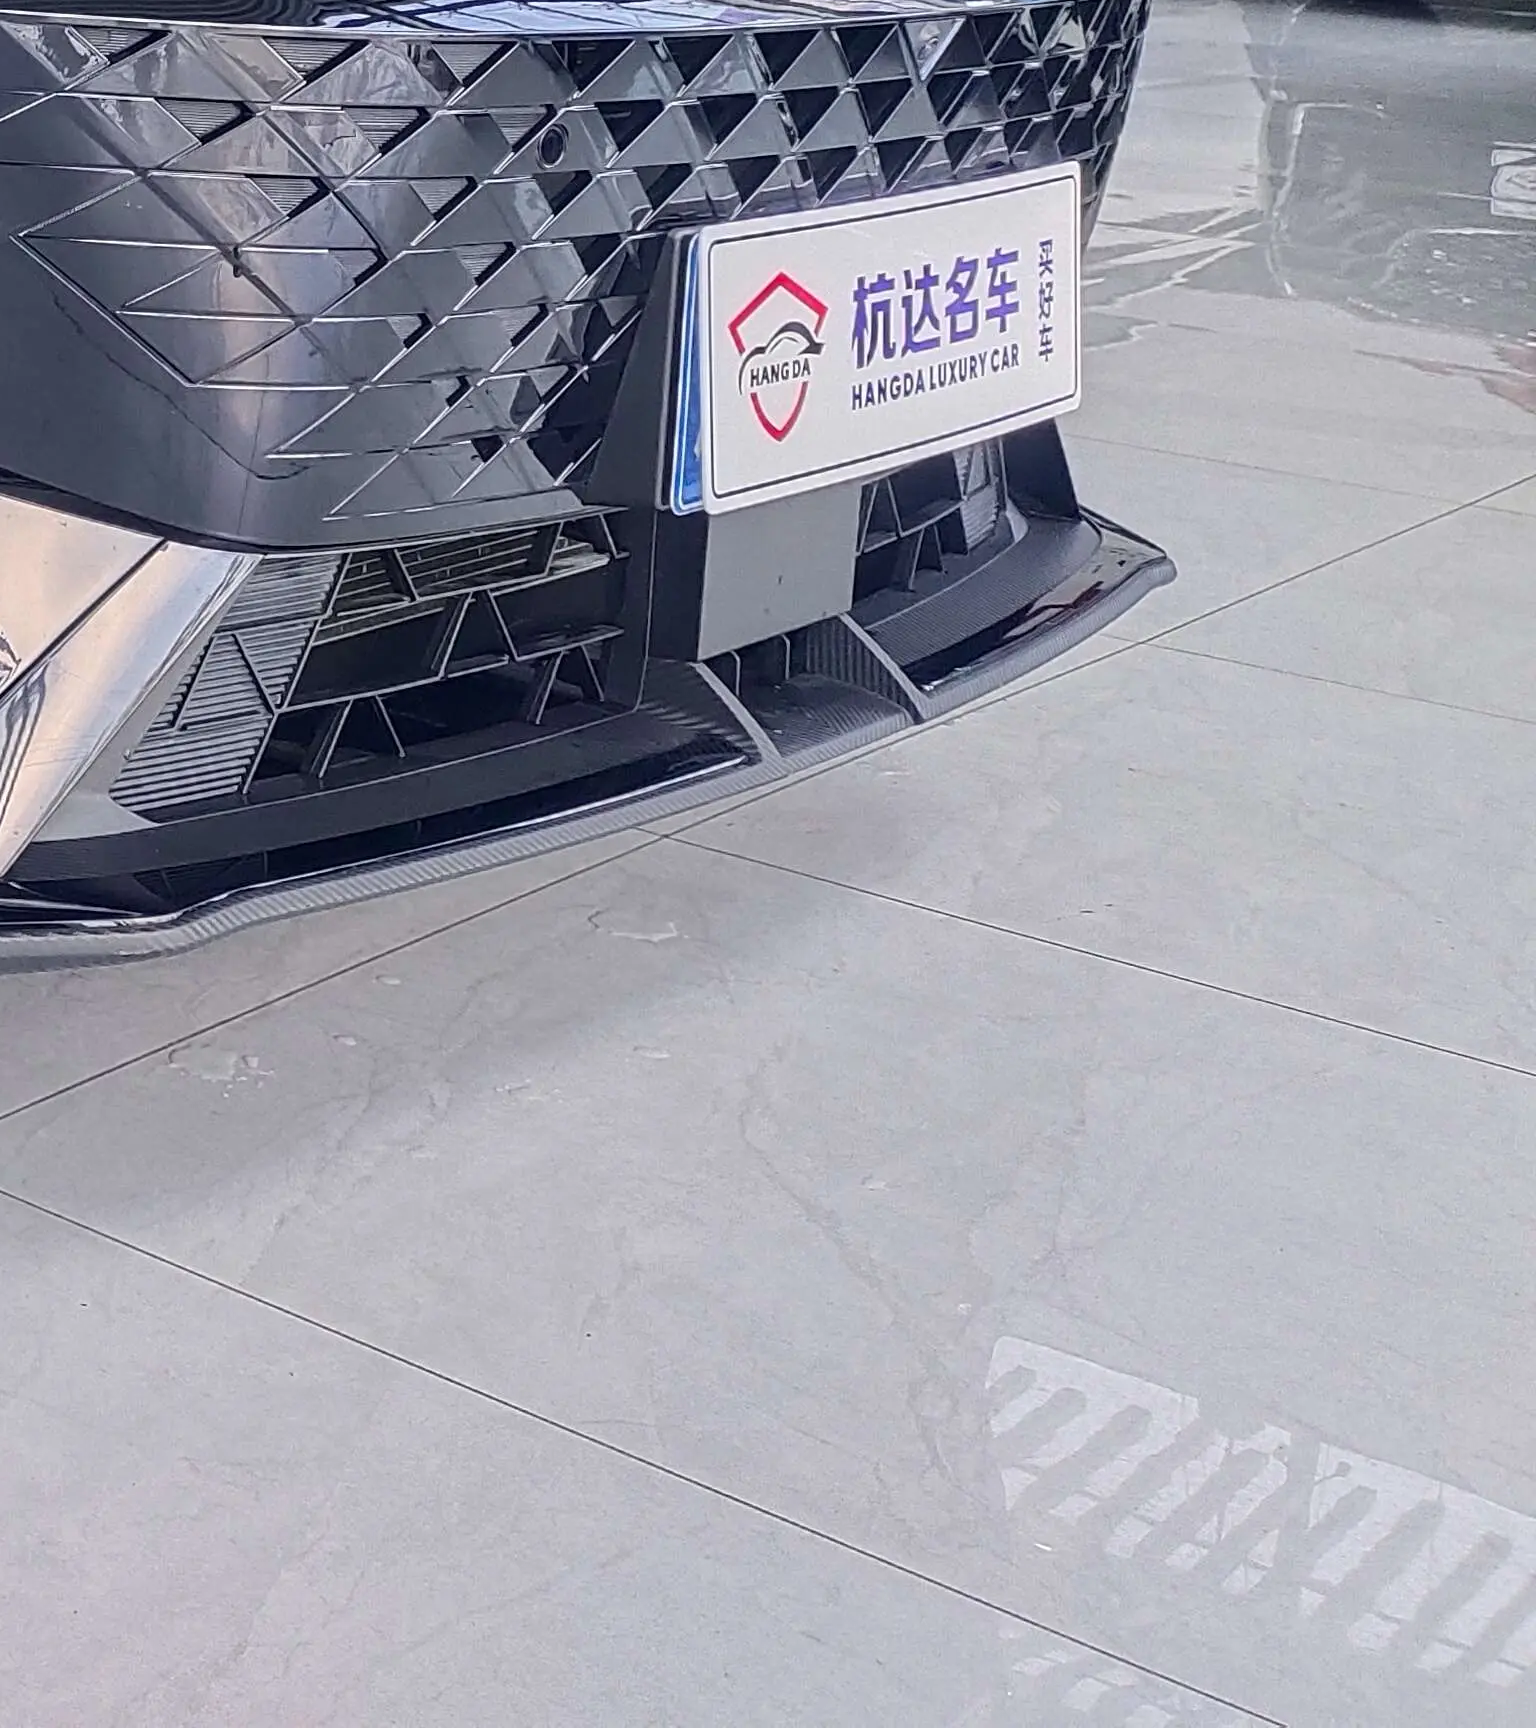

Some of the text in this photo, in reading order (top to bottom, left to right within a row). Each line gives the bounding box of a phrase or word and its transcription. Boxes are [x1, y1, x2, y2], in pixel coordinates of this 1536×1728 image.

[851, 247, 1020, 370] 杭达名车
[750, 357, 811, 387] HANG DA
[851, 343, 1020, 410] HANGDA LUXURY CAR
